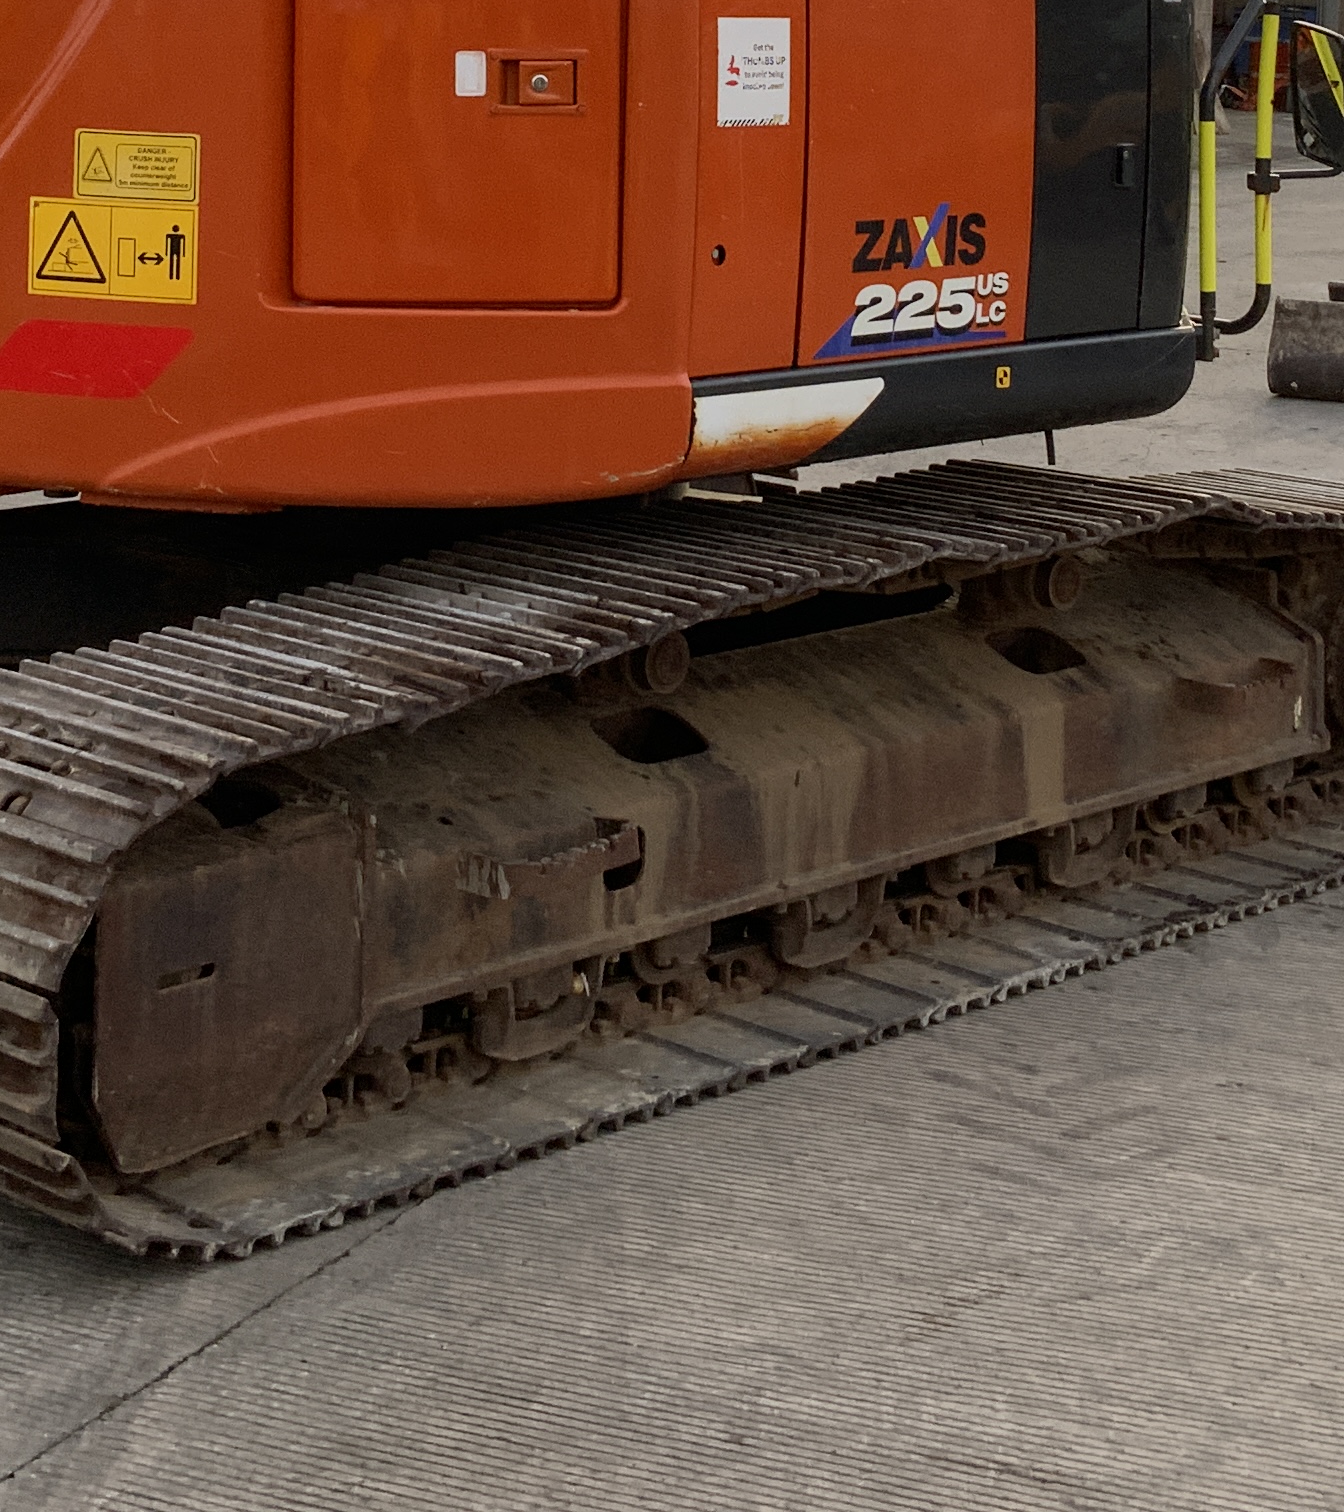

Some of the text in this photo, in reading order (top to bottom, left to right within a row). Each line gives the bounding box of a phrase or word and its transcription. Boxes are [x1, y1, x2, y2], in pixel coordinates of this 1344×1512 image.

[851, 202, 987, 274] ZAXIS
[851, 272, 1009, 342] 225 US
[975, 300, 1006, 326] LC
